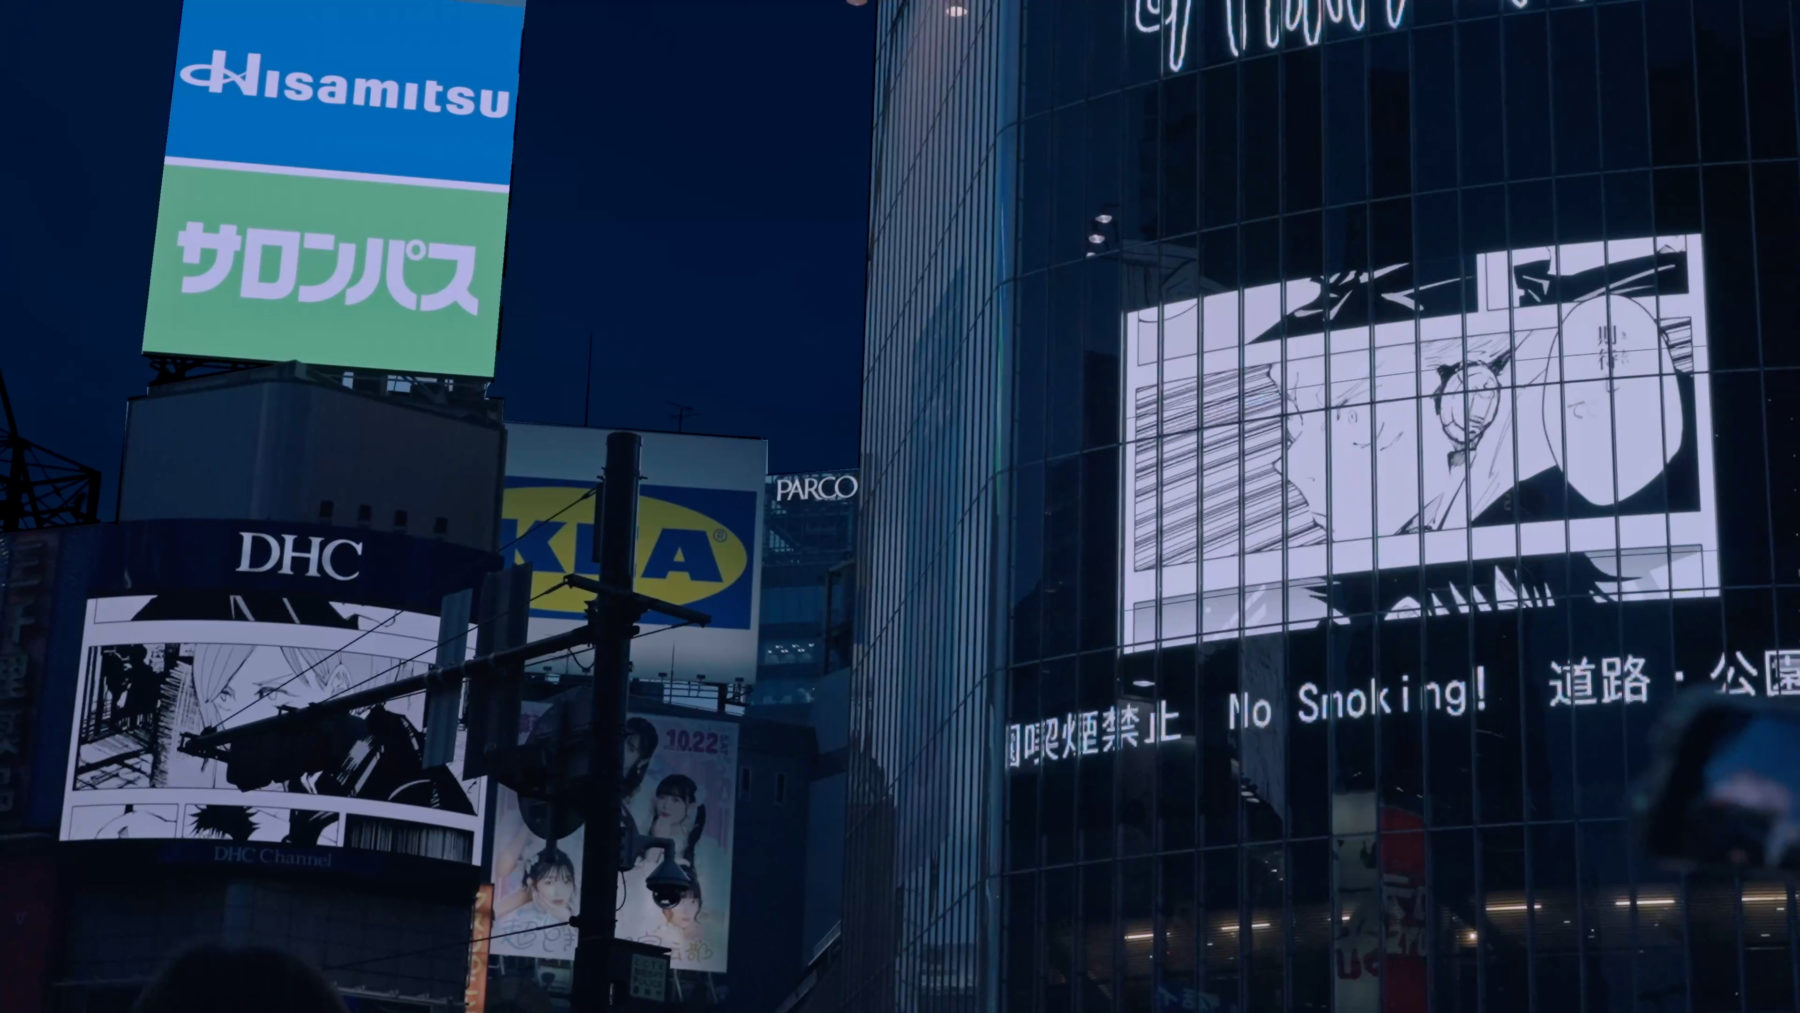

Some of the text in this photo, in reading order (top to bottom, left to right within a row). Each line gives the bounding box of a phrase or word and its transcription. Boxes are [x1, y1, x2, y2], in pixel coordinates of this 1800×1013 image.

[180, 49, 510, 119] Hisamitsu
[177, 221, 479, 316] サロンパス
[776, 475, 859, 502] PARCO
[235, 531, 363, 581] DHC
[1228, 691, 1272, 730] No
[1298, 664, 1486, 723] Smoking!
[666, 729, 718, 754] 10.22
[214, 846, 332, 868] DHC Channel
